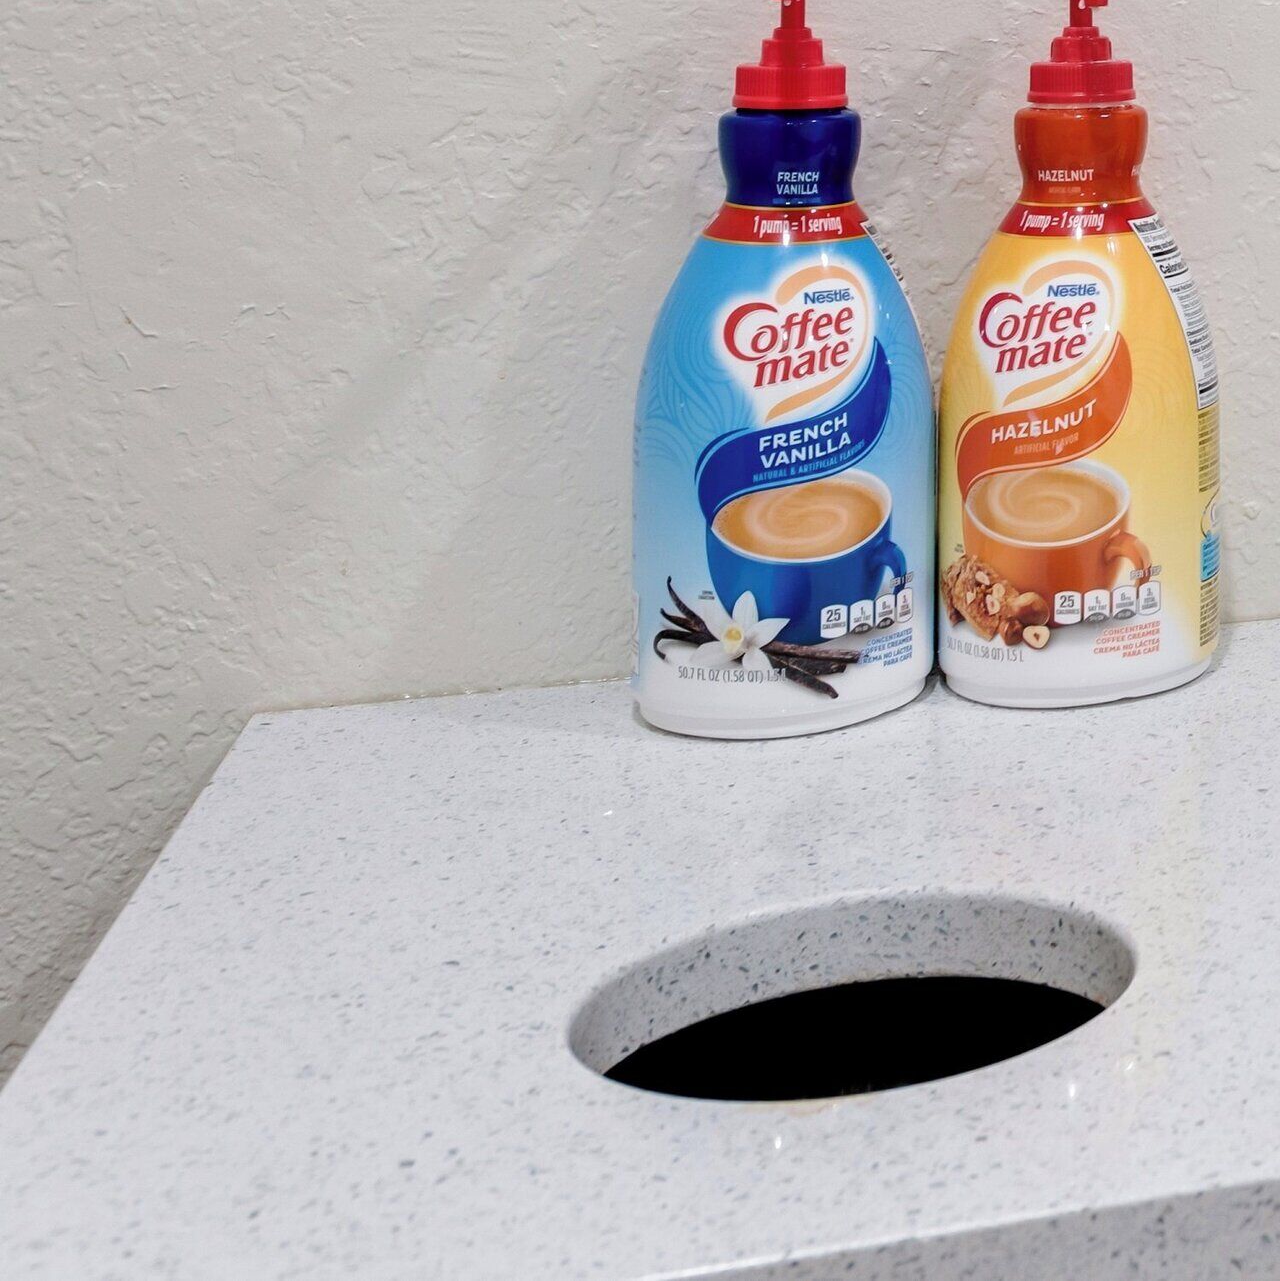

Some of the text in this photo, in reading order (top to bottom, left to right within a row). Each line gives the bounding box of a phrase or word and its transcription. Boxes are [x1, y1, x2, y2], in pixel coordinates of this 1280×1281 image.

[777, 171, 820, 183] FRENCH
[1038, 168, 1095, 182] HAZELNUT
[776, 183, 819, 195] VANILLA
[753, 215, 760, 233] 1
[759, 218, 790, 239] pump
[800, 215, 806, 233] 1
[808, 213, 843, 235] serving
[1019, 210, 1028, 227] 1
[1022, 215, 1051, 233] pump
[1060, 211, 1069, 229] 1
[1067, 210, 1105, 231] serving
[978, 292, 1097, 349] Coffee
[723, 302, 854, 362] Coffee
[995, 333, 1087, 374] mate
[753, 340, 850, 388] mate
[991, 398, 1097, 444] HAZELNUT
[758, 411, 848, 453] FRENCH
[760, 431, 852, 469] VANILLA
[1014, 441, 1051, 455] ARTIFICIAL
[752, 469, 788, 483] NATURAL
[799, 457, 838, 474] ARTIFICIAL
[1059, 595, 1075, 608] 25
[826, 608, 841, 623] 25
[697, 668, 706, 681] FL
[708, 669, 720, 682] OZ
